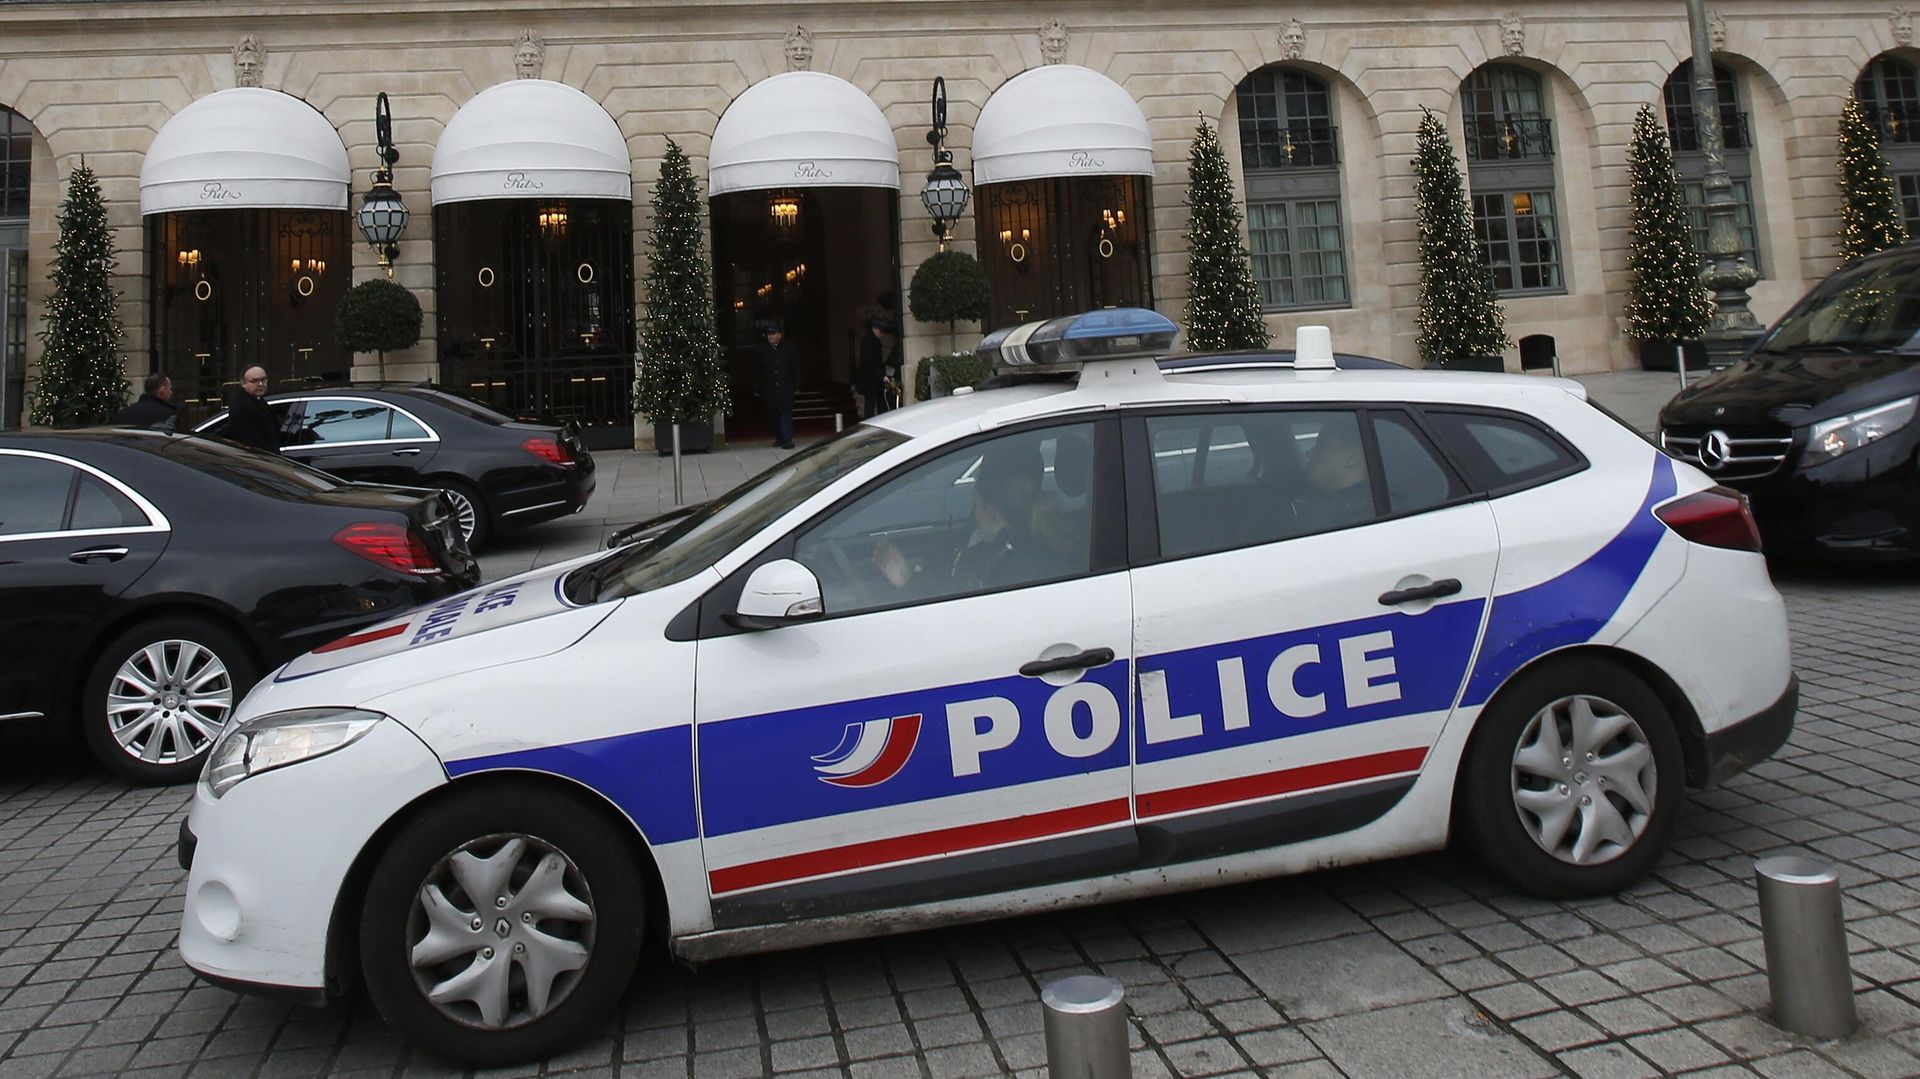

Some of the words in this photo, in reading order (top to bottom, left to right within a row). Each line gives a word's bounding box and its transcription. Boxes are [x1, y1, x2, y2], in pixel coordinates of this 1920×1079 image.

[1069, 151, 1105, 168] Ritz
[795, 161, 833, 178] Ritz
[504, 172, 544, 190] Ritz
[200, 182, 242, 200] Ritz
[945, 630, 1402, 778] POLICE
